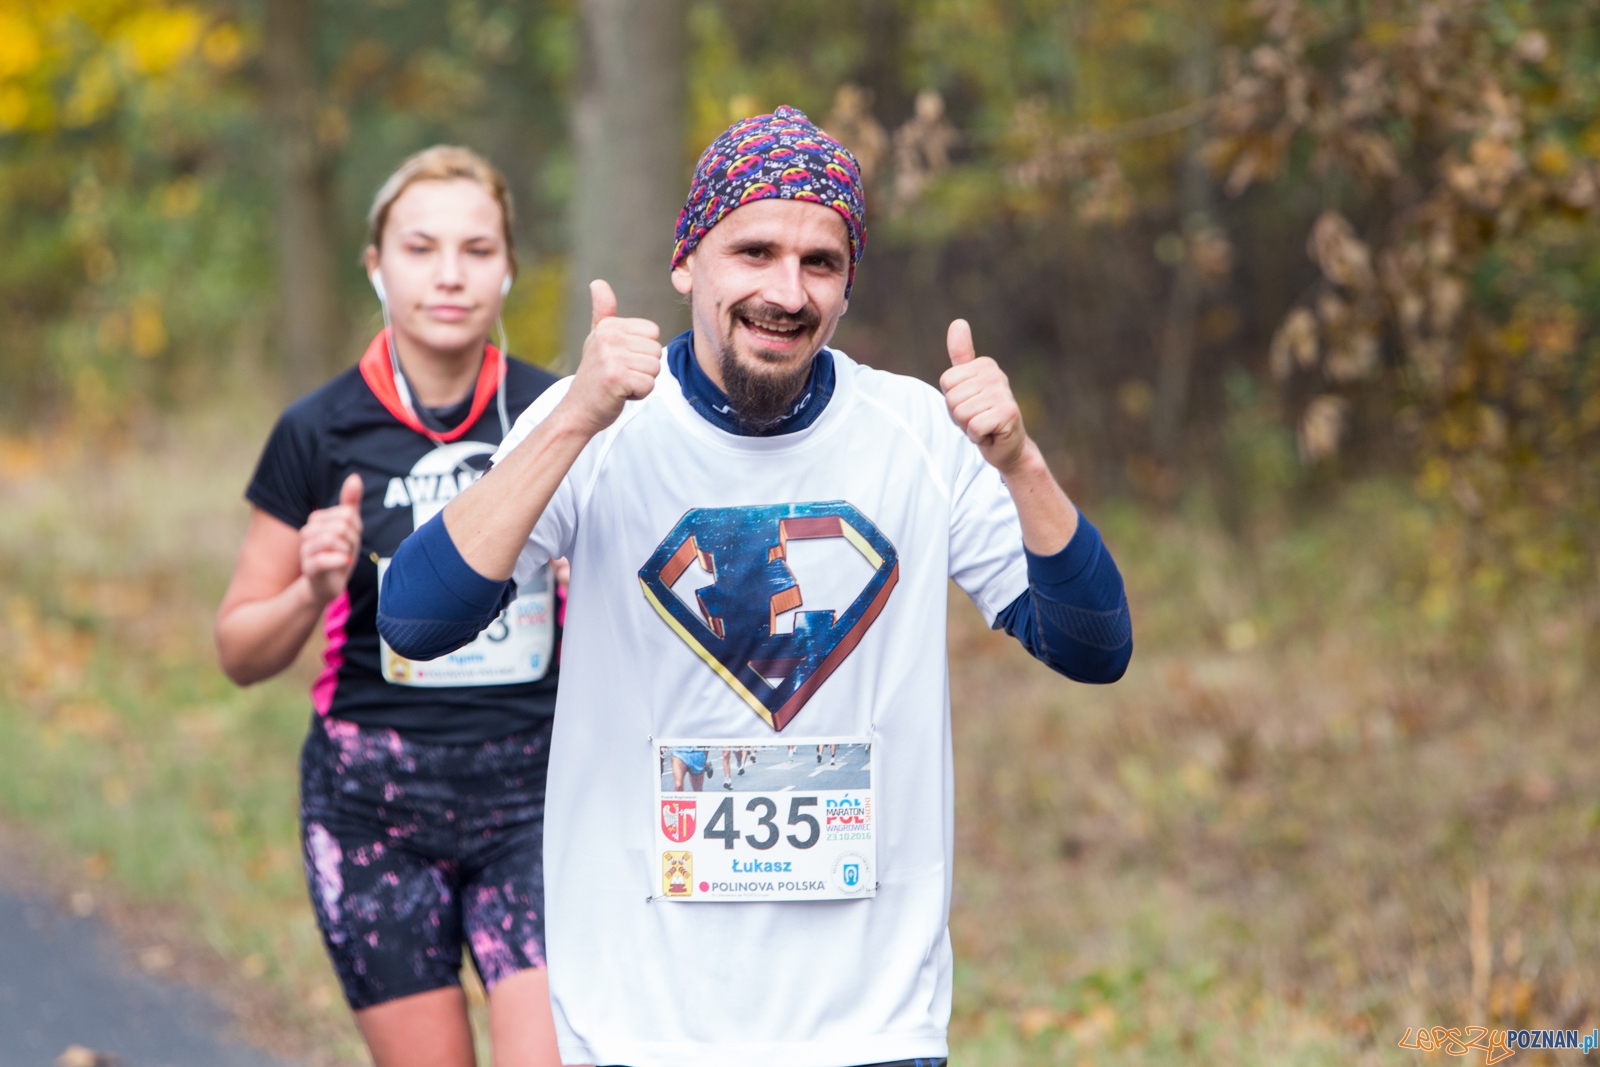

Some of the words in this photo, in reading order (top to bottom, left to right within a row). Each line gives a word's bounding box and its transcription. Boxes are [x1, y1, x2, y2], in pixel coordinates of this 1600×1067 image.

[826, 807, 865, 816] MARATON
[703, 796, 821, 850] 435
[826, 824, 871, 833] WĄGROWIEC
[826, 833, 872, 841] 23.10.2016
[732, 859, 792, 873] Łukasz
[712, 881, 775, 892] POLINOVA
[778, 880, 826, 891] POLSKA
